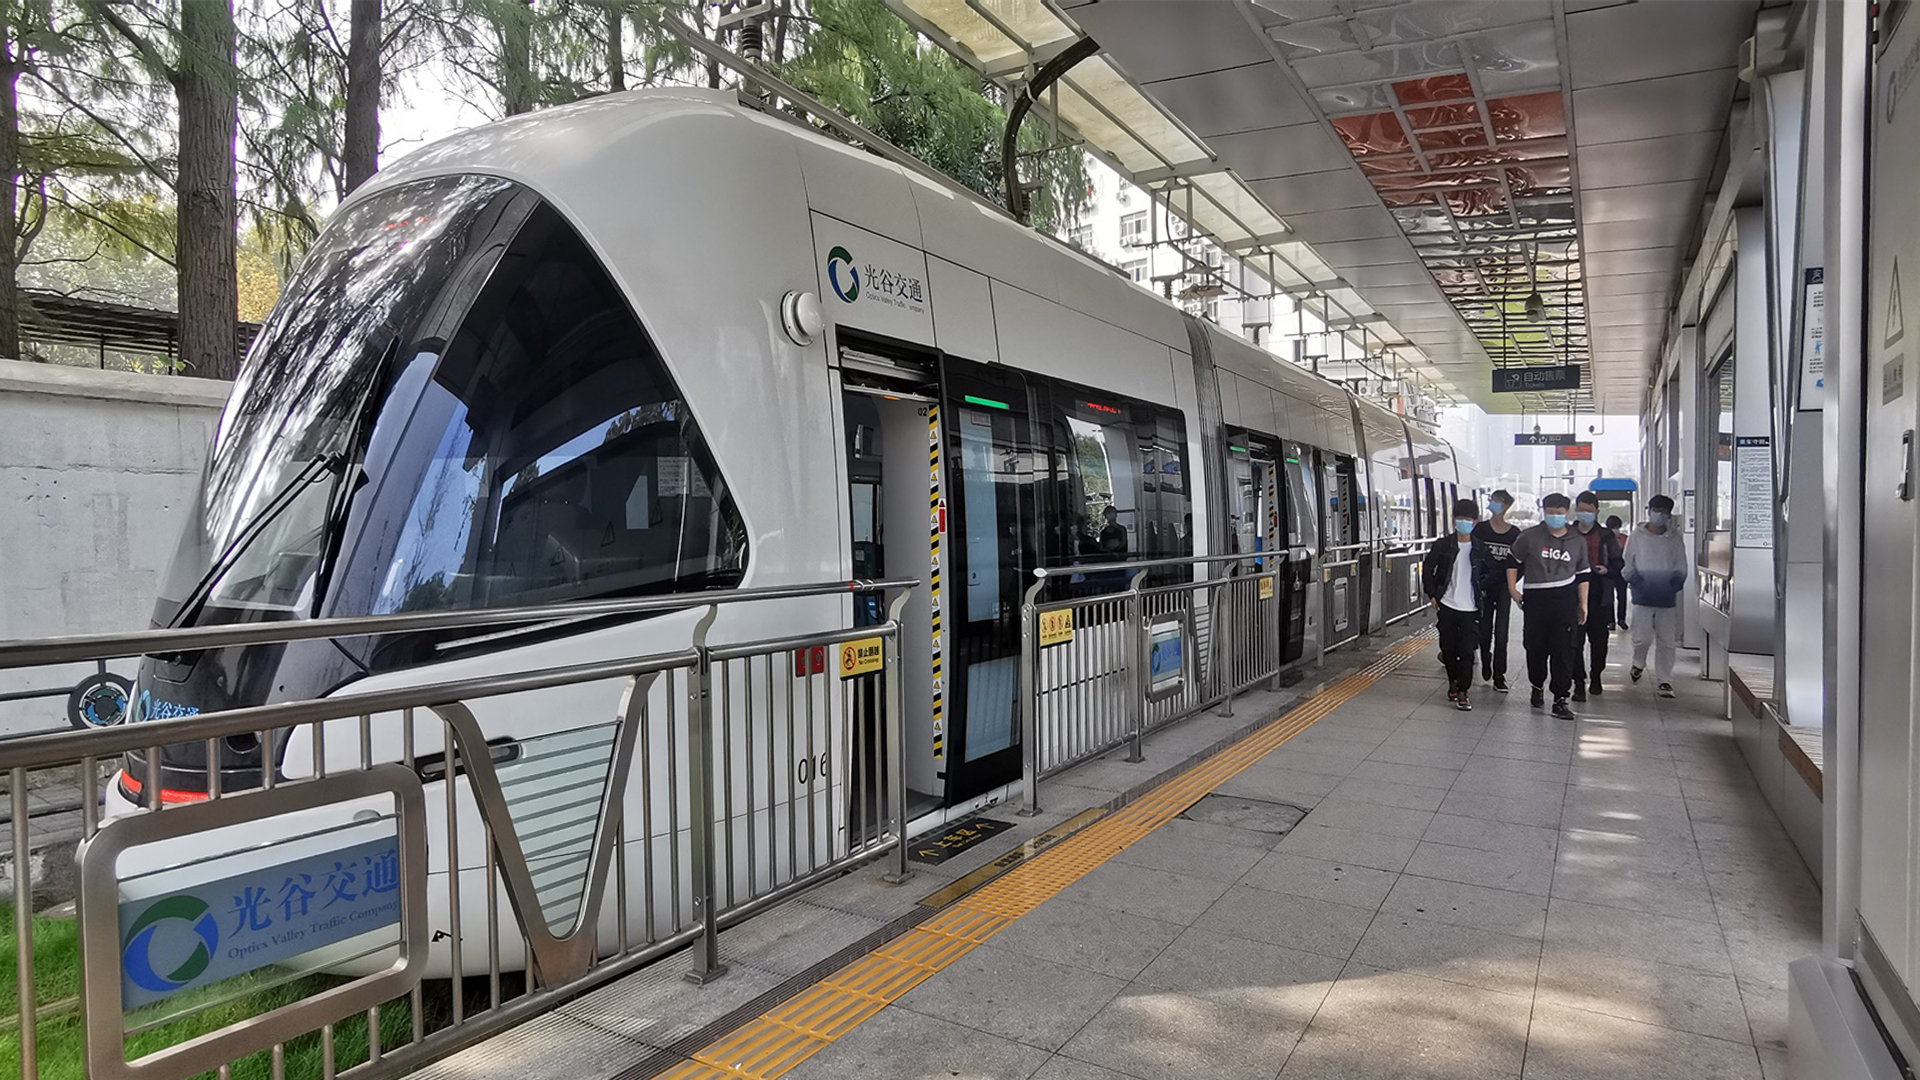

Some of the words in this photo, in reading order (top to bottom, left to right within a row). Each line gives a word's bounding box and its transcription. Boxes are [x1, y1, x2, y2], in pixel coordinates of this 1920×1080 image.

[864, 264, 923, 303] 光谷交通
[917, 407, 928, 416] 02
[227, 848, 399, 939] 光谷交通
[228, 941, 268, 959] Optics
[271, 930, 305, 945] Valley
[309, 915, 346, 933] Traffic
[349, 901, 398, 921] Company
